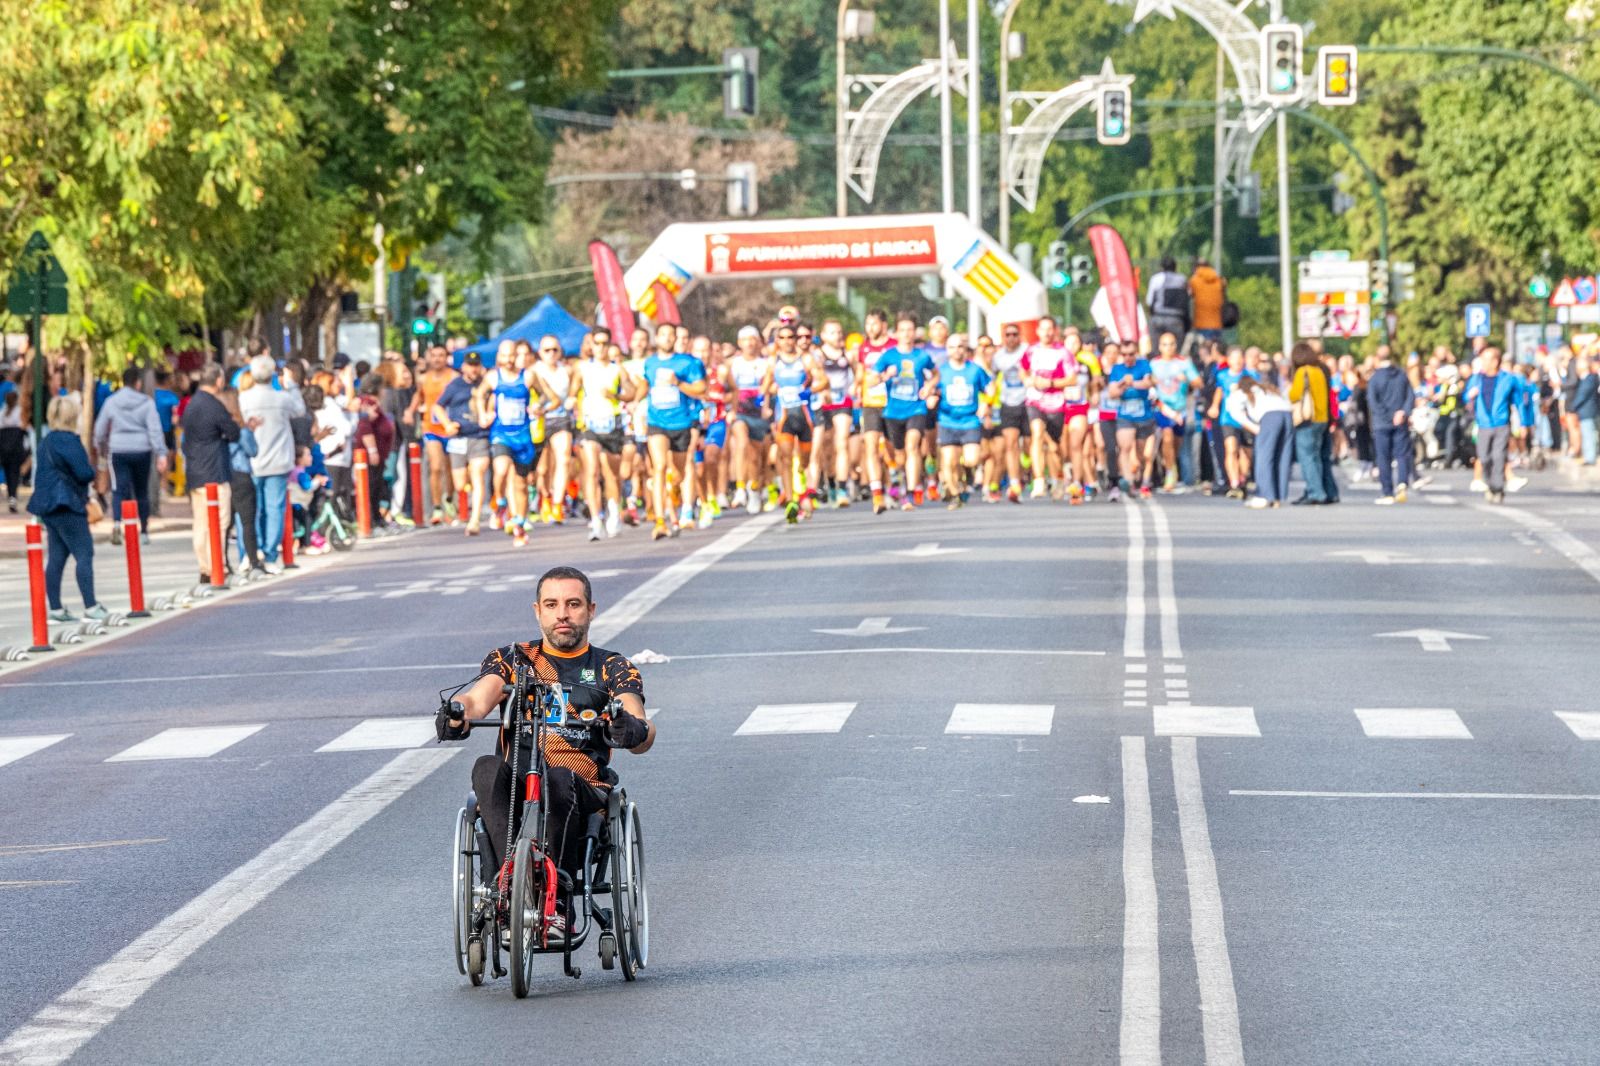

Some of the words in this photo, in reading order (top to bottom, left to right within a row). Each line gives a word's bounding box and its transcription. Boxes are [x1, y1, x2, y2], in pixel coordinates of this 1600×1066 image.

[736, 243, 849, 262] AYUNTAMIENTO
[851, 242, 870, 258] DE
[873, 240, 931, 257] MURCIA
[1470, 307, 1486, 335] P
